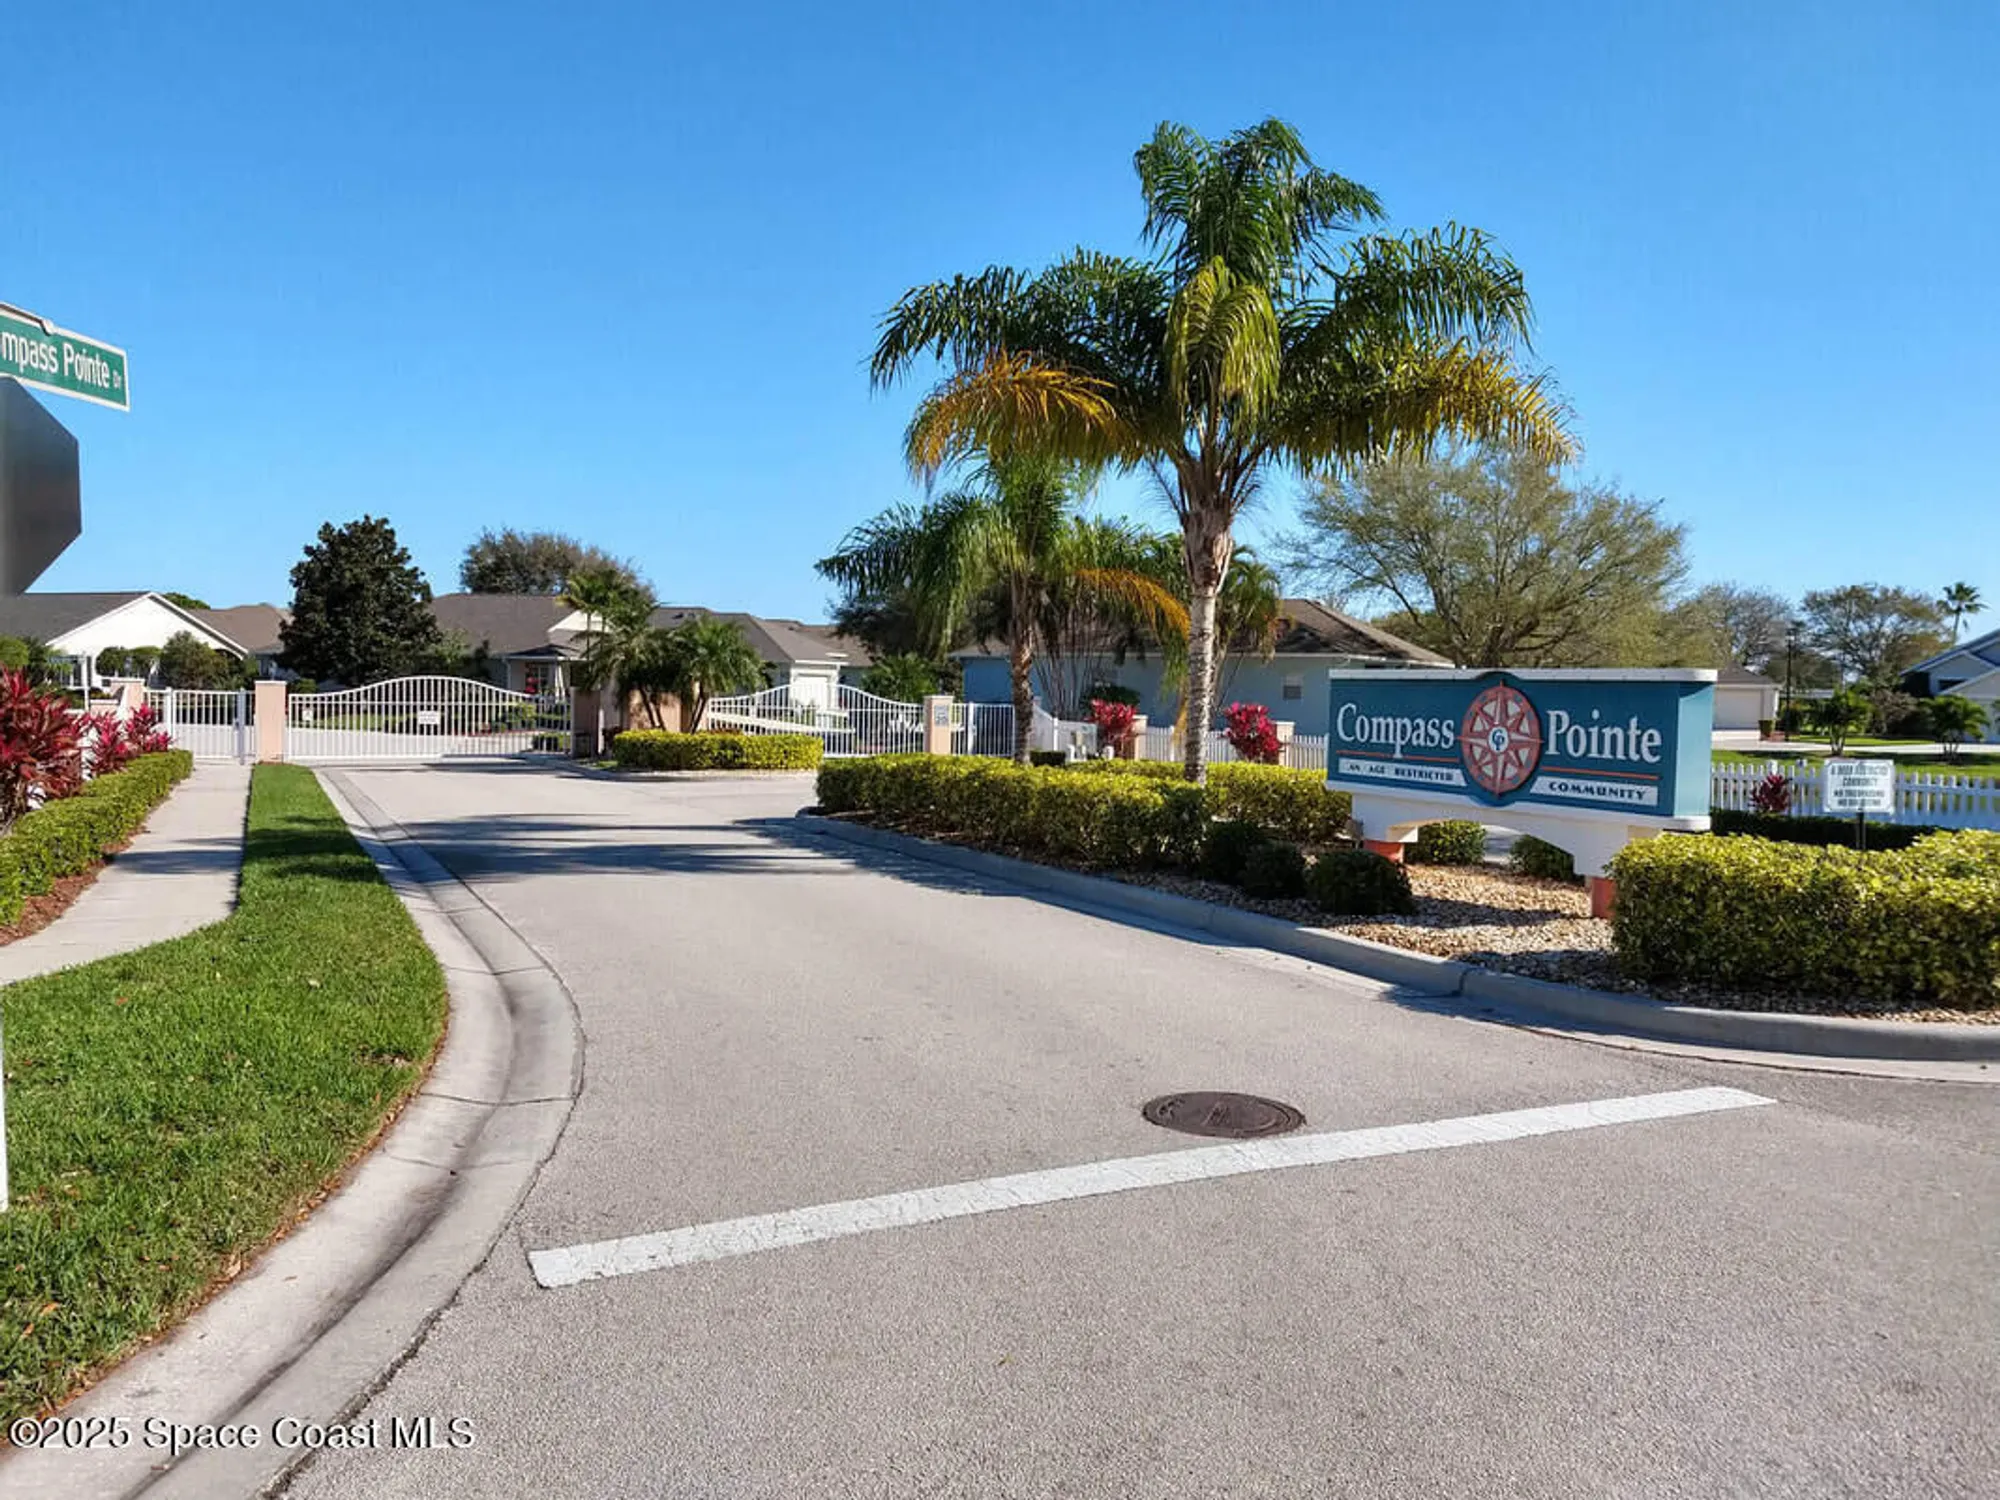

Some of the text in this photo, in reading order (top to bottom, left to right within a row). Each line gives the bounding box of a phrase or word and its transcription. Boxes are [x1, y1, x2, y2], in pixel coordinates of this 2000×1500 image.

[1, 331, 59, 374] mpass
[63, 342, 110, 389] Pointe
[1337, 702, 1663, 763] Compass Pointe
[1394, 767, 1454, 781] RESTRICTED
[1549, 781, 1646, 800] COMMUNITY
